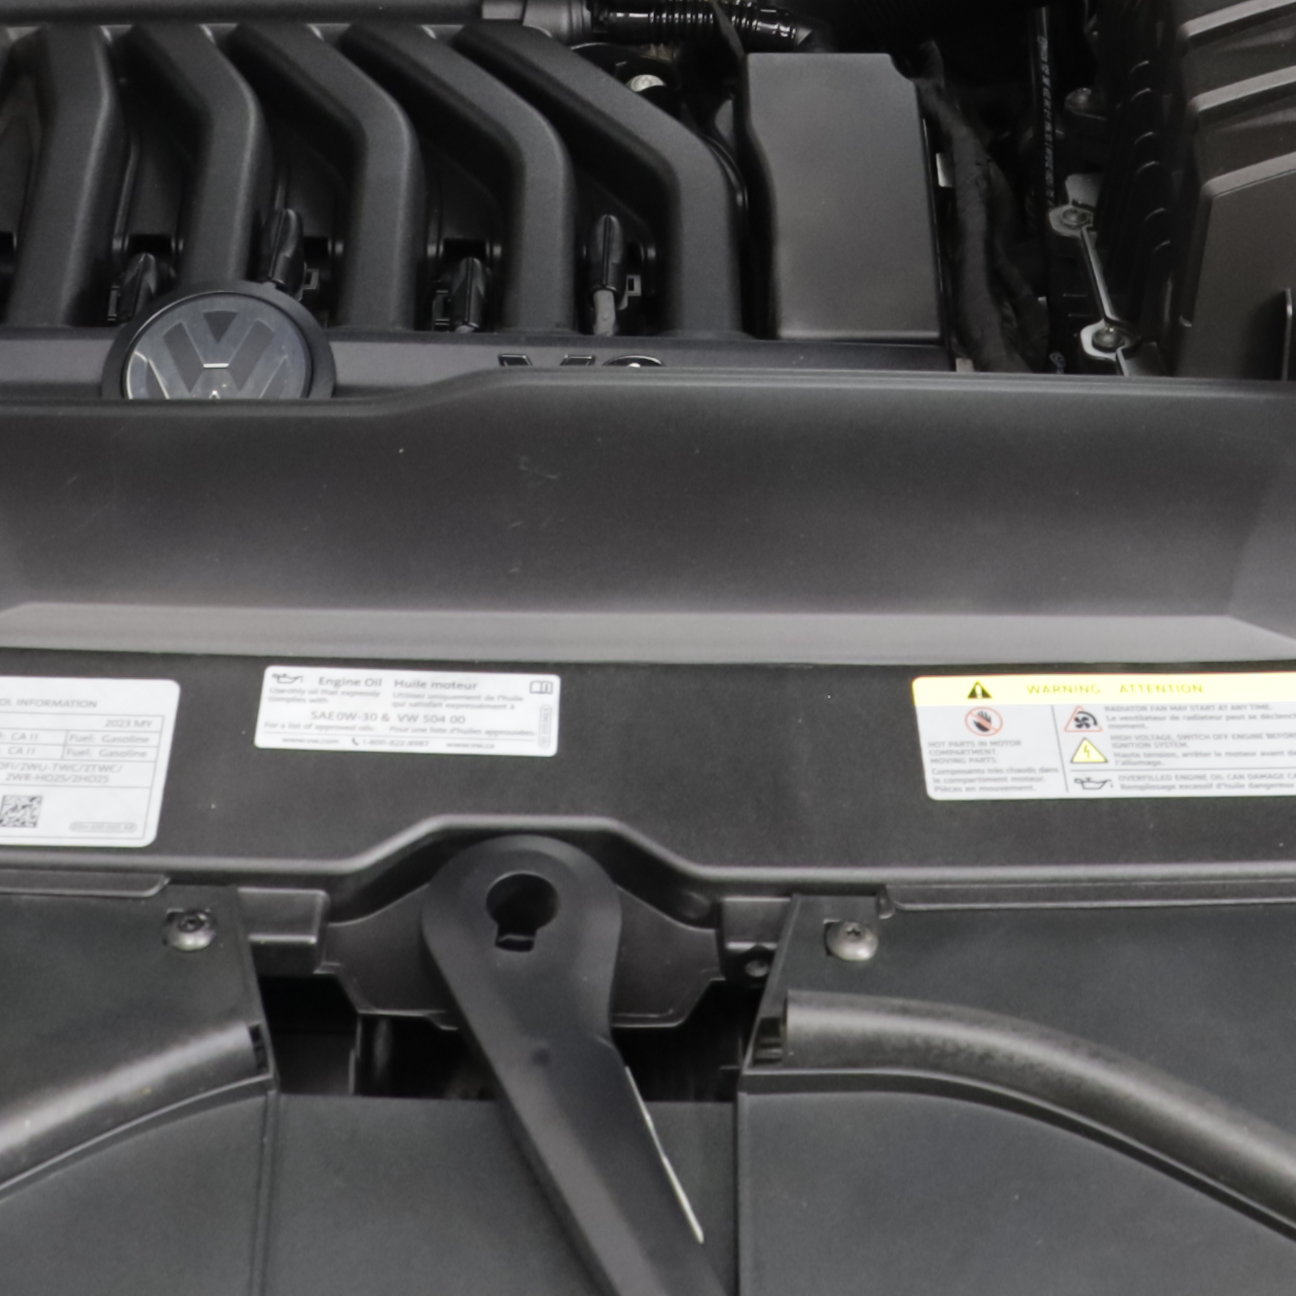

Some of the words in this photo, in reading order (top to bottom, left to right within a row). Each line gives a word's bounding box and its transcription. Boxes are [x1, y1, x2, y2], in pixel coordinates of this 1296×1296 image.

[318, 676, 361, 688] Engine
[364, 677, 384, 688] Oil
[394, 679, 428, 690] Huile
[431, 680, 479, 691] moteur
[1026, 684, 1102, 695] WARNING
[1120, 683, 1206, 694] ATTENTION
[16, 698, 99, 709] INFORMATION
[310, 710, 335, 721] SAE
[336, 711, 378, 722] 0W-30
[398, 713, 420, 723] VW
[423, 714, 447, 724] 504
[449, 715, 467, 725] 00
[105, 719, 131, 728] 2023
[133, 720, 153, 729] MY
[11, 732, 28, 741] CA
[101, 735, 151, 745] Gasoline
[7, 746, 25, 756] CA
[98, 749, 149, 759] Gasoline
